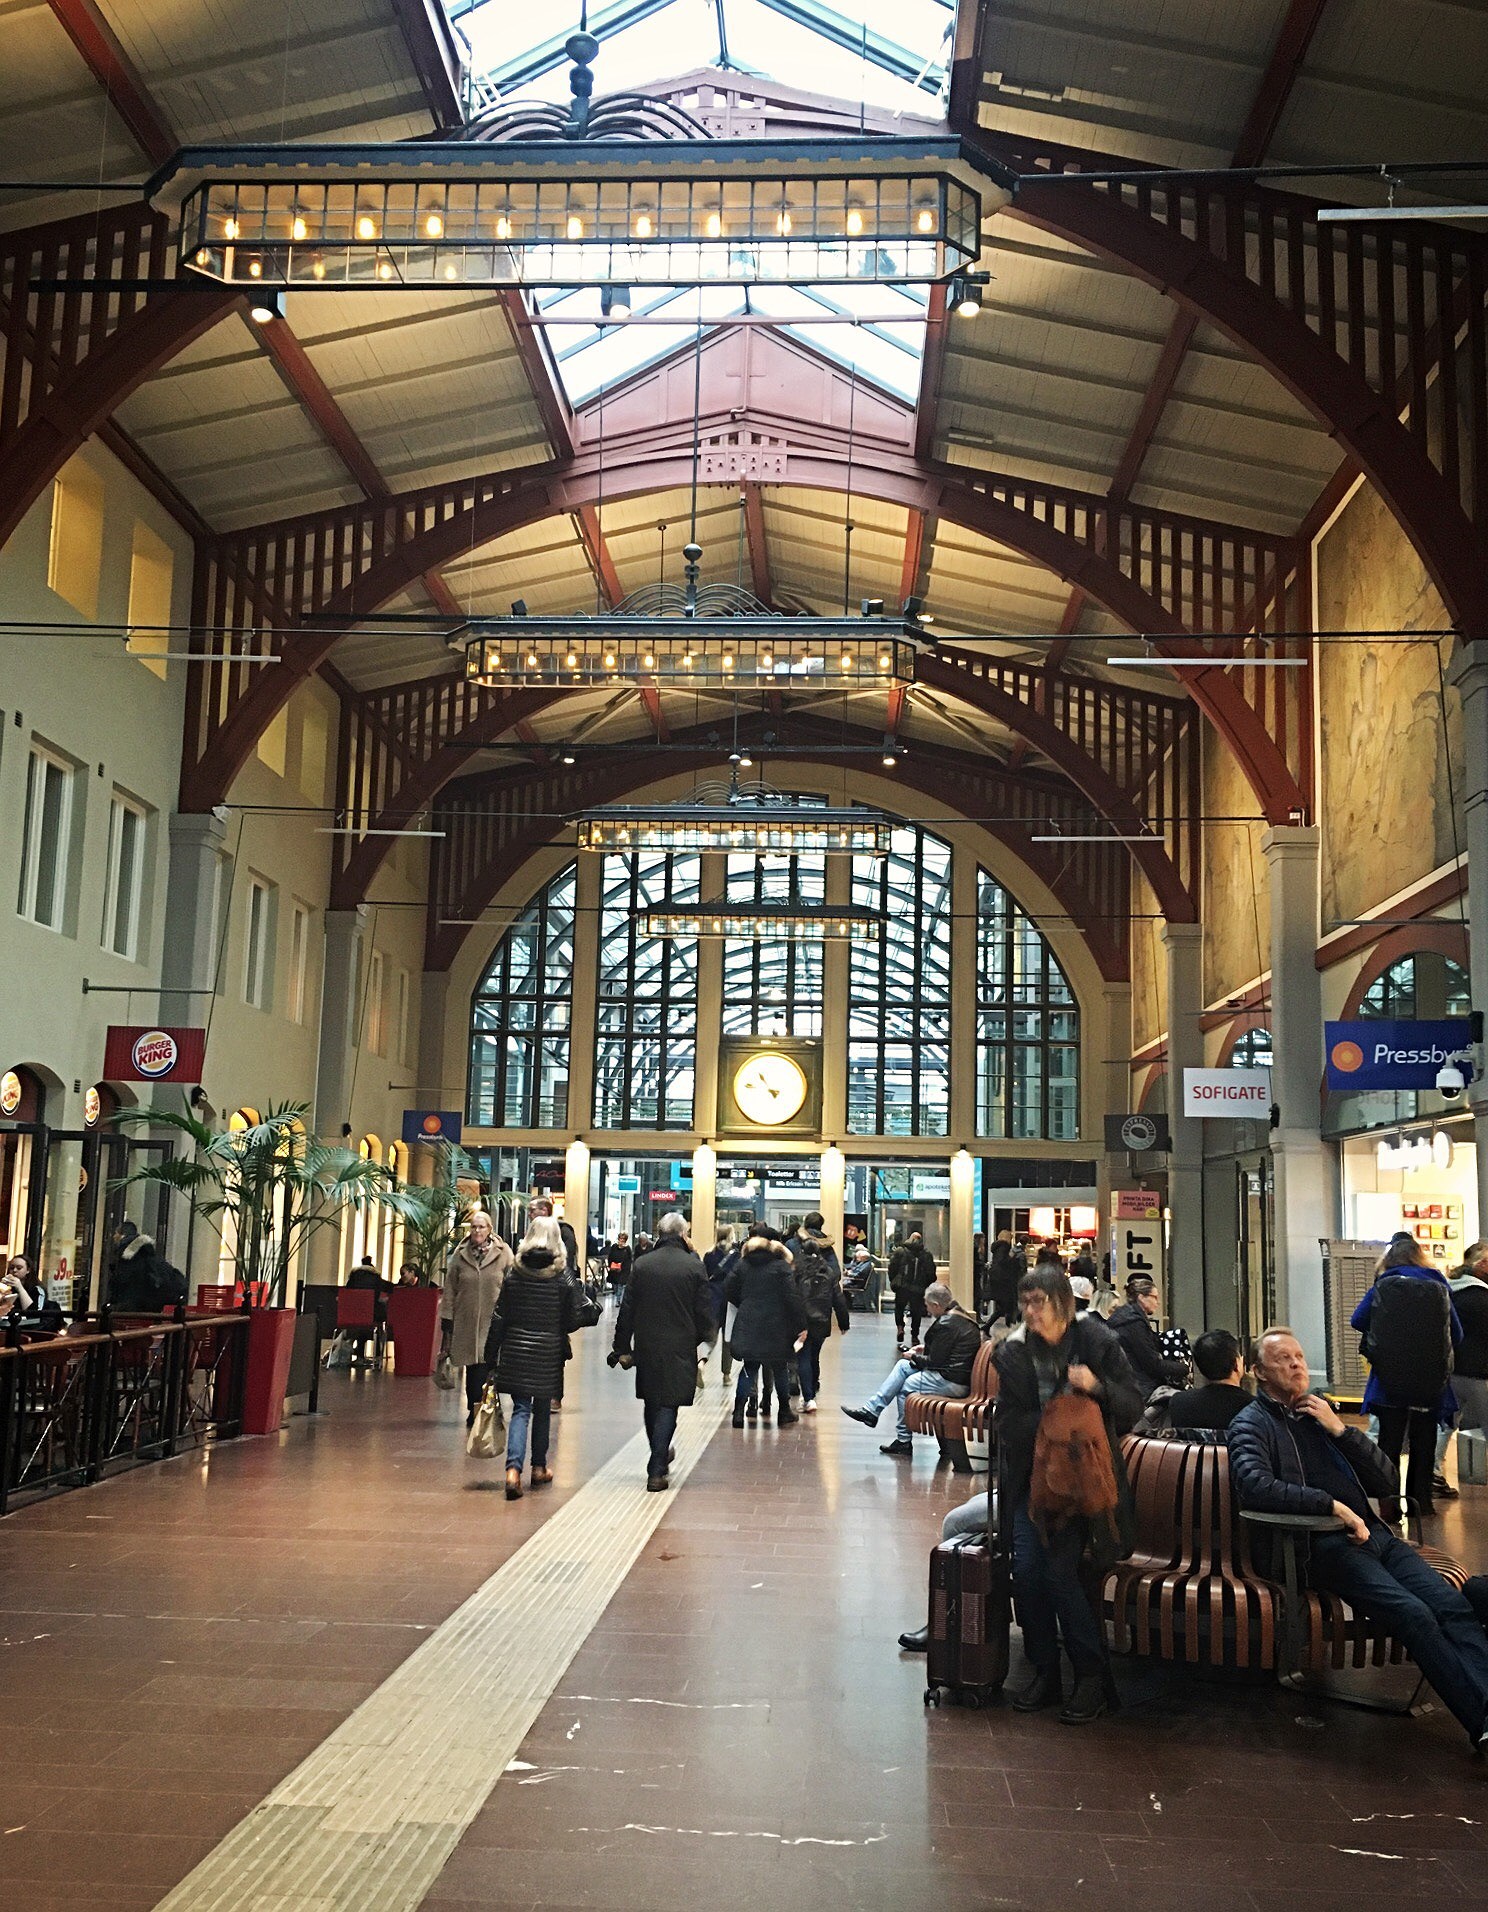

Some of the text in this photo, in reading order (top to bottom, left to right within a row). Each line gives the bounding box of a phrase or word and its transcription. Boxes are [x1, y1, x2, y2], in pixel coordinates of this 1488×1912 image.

[137, 1039, 172, 1056] BURGER
[137, 1047, 173, 1066] KING
[1192, 1085, 1266, 1101] SOFIGATE
[767, 1170, 795, 1178] Toaletter
[651, 1192, 675, 1200] LINDEX
